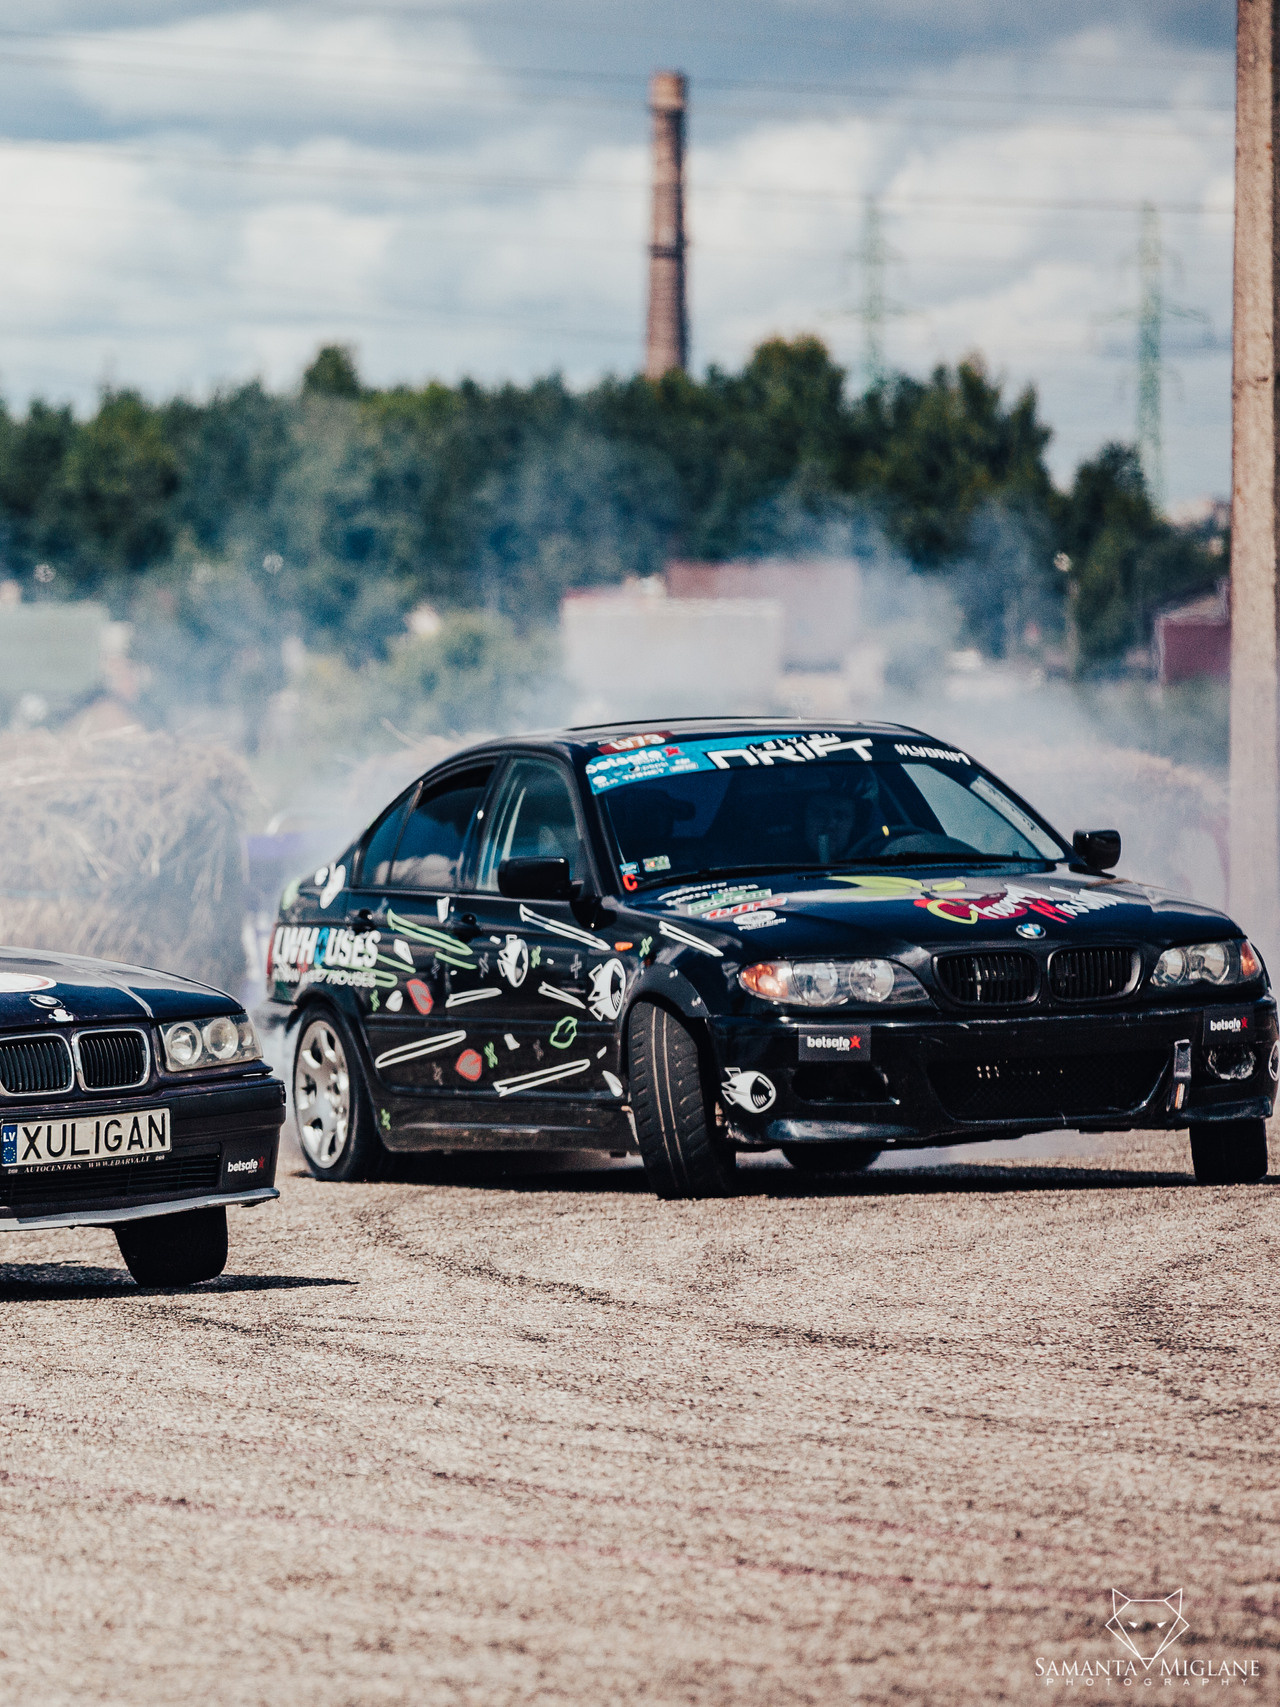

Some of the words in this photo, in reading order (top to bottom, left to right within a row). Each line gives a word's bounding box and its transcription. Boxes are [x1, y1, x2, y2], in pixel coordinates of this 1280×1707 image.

[1210, 1017, 1241, 1031] betsafe
[806, 1035, 851, 1048] betsafe
[3, 1132, 16, 1142] LV
[21, 1112, 167, 1161] XULIGAN
[24, 1163, 82, 1174] AUTOCENTRAS
[227, 1158, 258, 1173] betsafe
